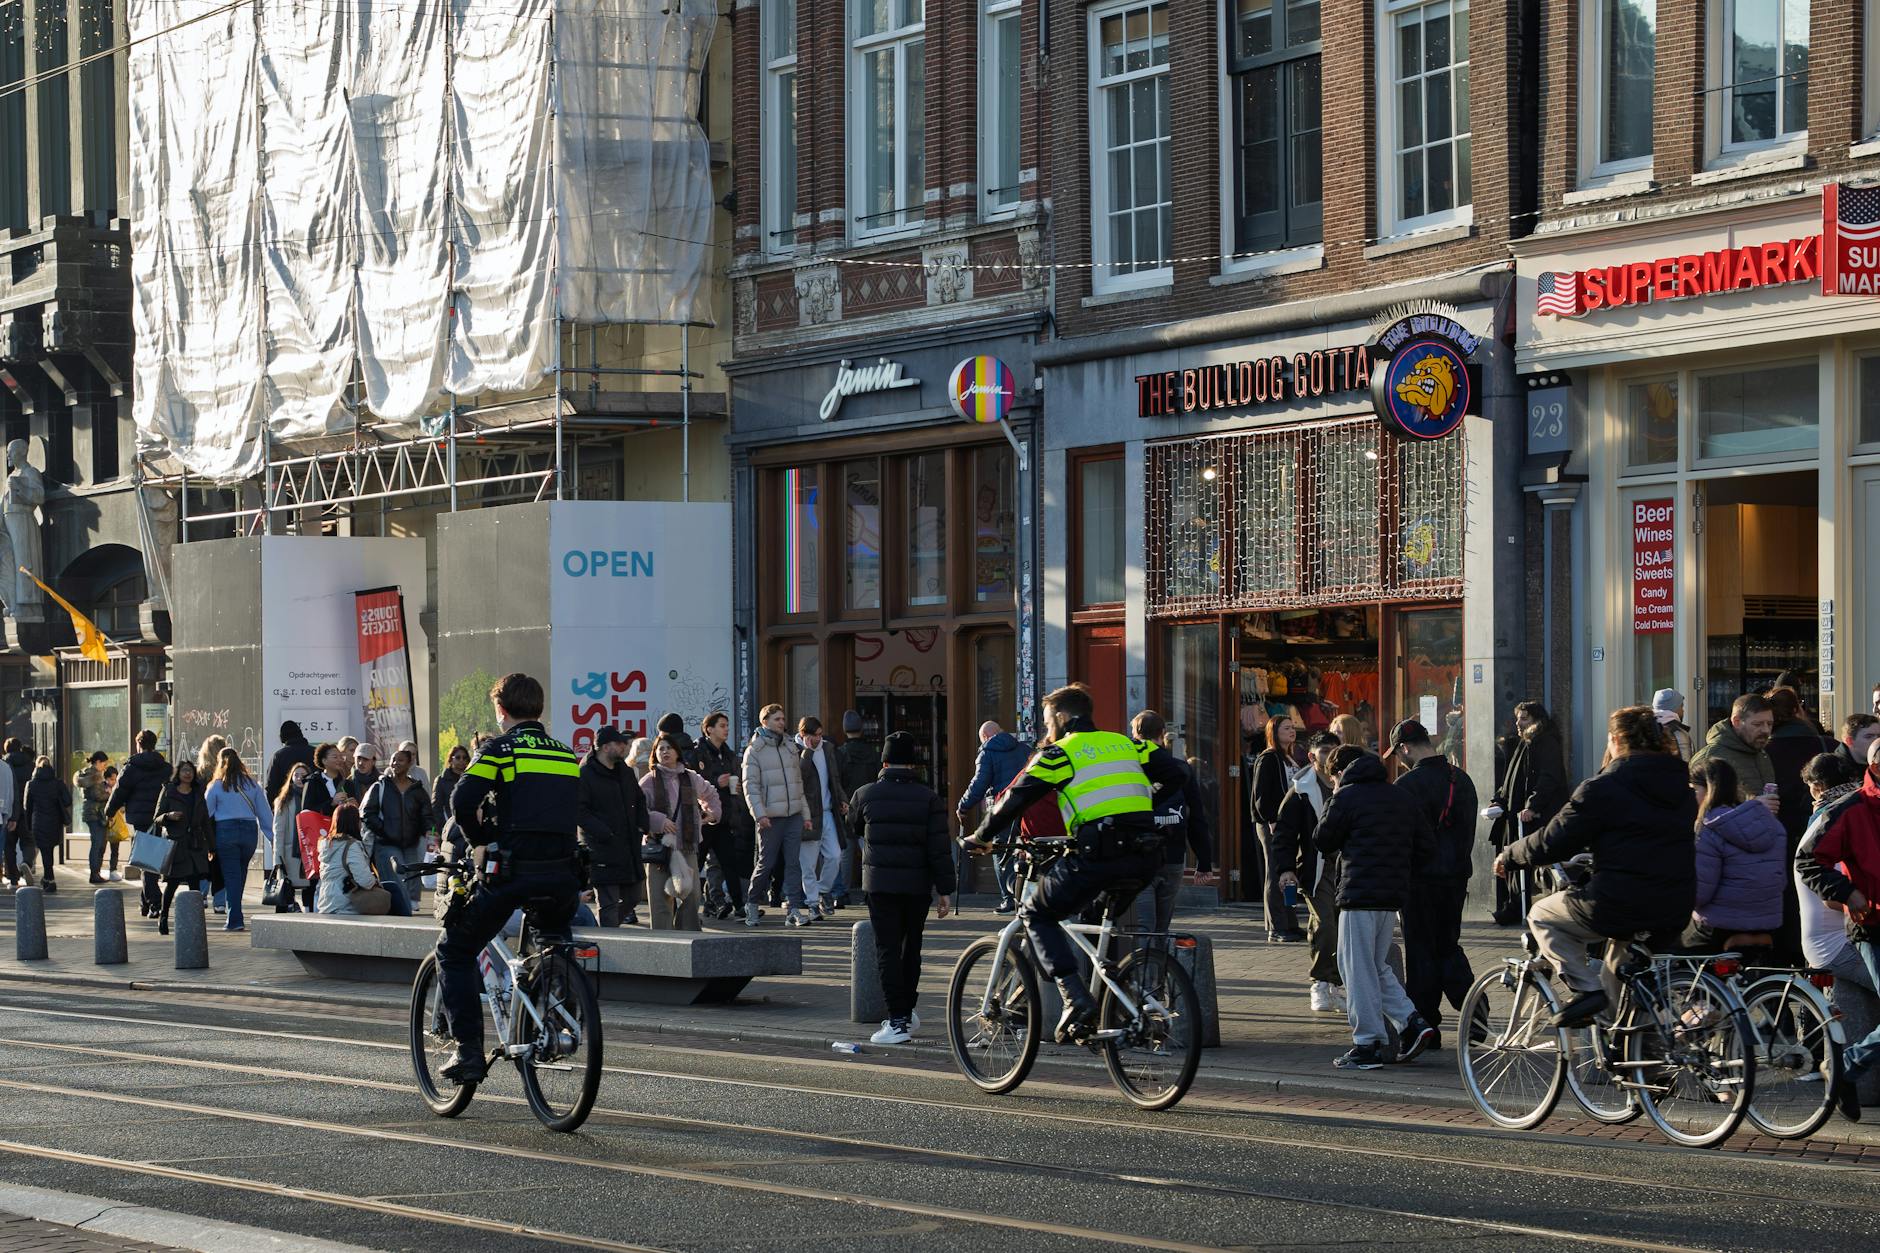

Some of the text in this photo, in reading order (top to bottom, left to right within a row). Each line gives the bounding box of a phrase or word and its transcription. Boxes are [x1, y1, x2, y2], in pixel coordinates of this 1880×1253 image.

[1847, 246, 1880, 268] SU
[1381, 315, 1479, 354] THE BULLDOG
[819, 357, 921, 421] jamin
[959, 380, 1013, 400] jamin
[1135, 344, 1370, 417] THE BULLDOG GOTTA
[1532, 402, 1564, 438] 23
[1635, 504, 1673, 523] Beer
[1635, 527, 1673, 543] Wines
[563, 550, 654, 577] OPEN
[1635, 550, 1662, 566] USA
[1635, 566, 1673, 581] Sweets
[1641, 586, 1668, 600] Candy
[1635, 603, 1673, 615] Ice Cream
[1634, 618, 1674, 630] Cold Drinks
[300, 685, 321, 696] real
[324, 687, 357, 696] estate
[611, 670, 647, 738] ETS
[1153, 814, 1180, 825] PUMA
